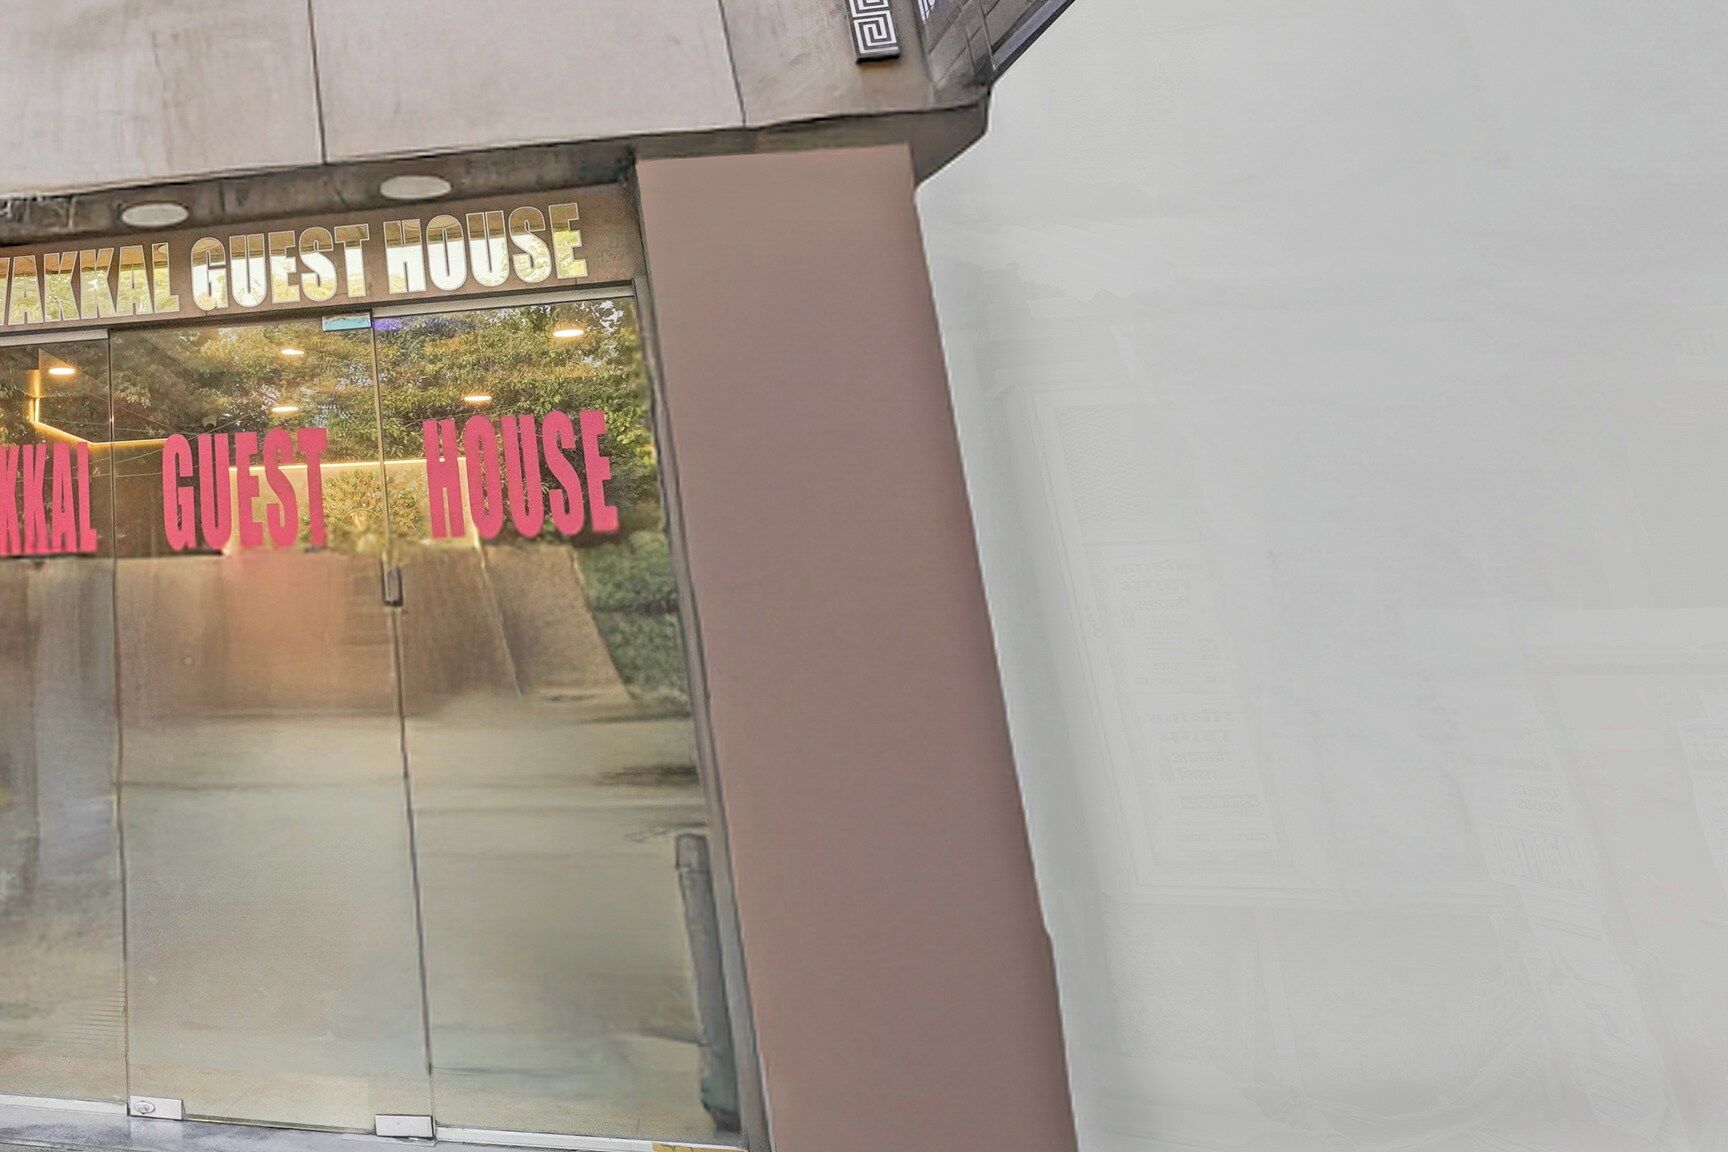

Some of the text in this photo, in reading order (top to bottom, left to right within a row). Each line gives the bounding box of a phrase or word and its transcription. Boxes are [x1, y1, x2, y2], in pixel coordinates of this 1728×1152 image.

[191, 223, 370, 311] GUEST
[383, 203, 588, 295] HOUSE
[162, 426, 328, 551] GUEST
[421, 409, 620, 539] HOUSE
